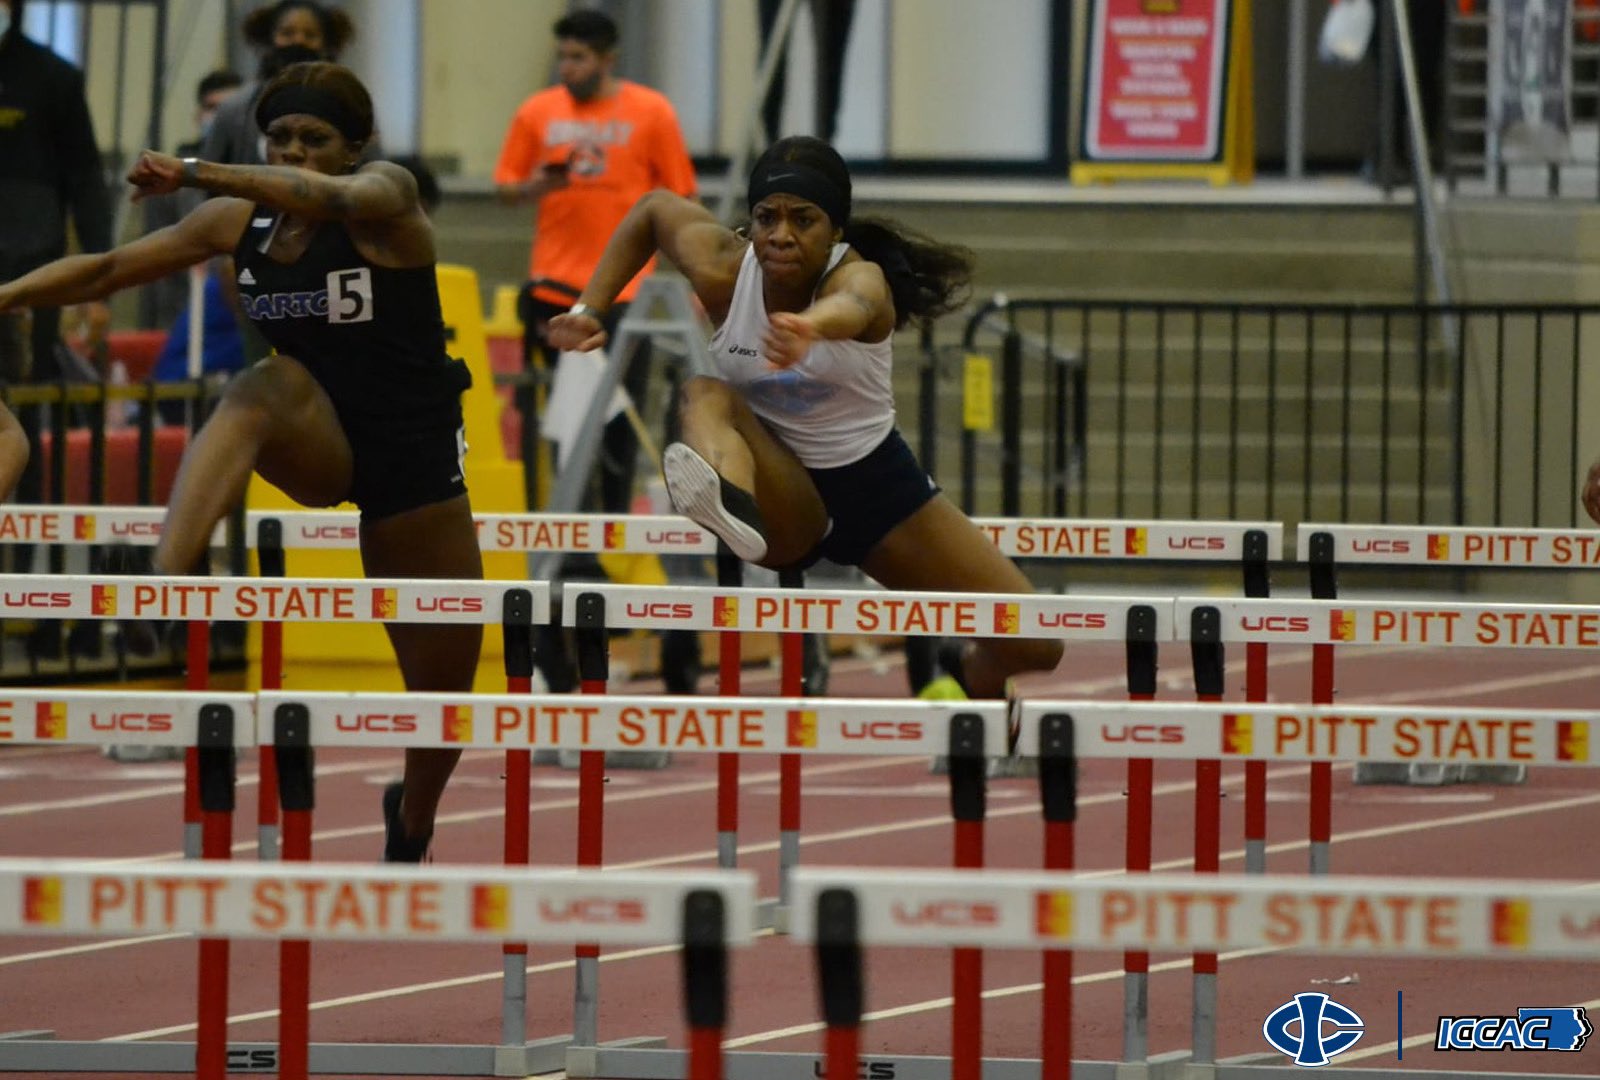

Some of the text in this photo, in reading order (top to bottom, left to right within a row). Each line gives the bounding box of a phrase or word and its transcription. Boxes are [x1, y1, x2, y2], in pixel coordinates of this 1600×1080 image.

[239, 289, 330, 320] BARTO
[338, 272, 363, 321] 5
[302, 526, 357, 540] UCS
[497, 521, 590, 548] STATE
[646, 530, 703, 545] UCS
[1016, 526, 1111, 555] STATE
[1168, 536, 1225, 551] UCS
[1352, 539, 1410, 553] UCS
[1464, 534, 1600, 565] PITT ST
[4, 592, 72, 608] UCS
[134, 585, 354, 619] PITT STATE
[416, 597, 483, 613] UCS
[626, 602, 694, 619] UCS
[756, 597, 976, 634] PITT STATE
[1038, 612, 1106, 629] UCS
[1241, 615, 1310, 633] UCS
[1373, 610, 1600, 646] PITT STATE
[90, 712, 173, 732] UCS
[336, 714, 418, 733] UCS
[494, 705, 764, 747] PITT STATE
[841, 721, 923, 741] UCS
[1101, 725, 1185, 744] UCS
[1275, 715, 1536, 761] PITT STATE
[90, 876, 442, 932] PITT STATE
[540, 899, 646, 923] UCS
[893, 901, 1000, 927] UCS
[1100, 891, 1459, 949] PITT STATE
